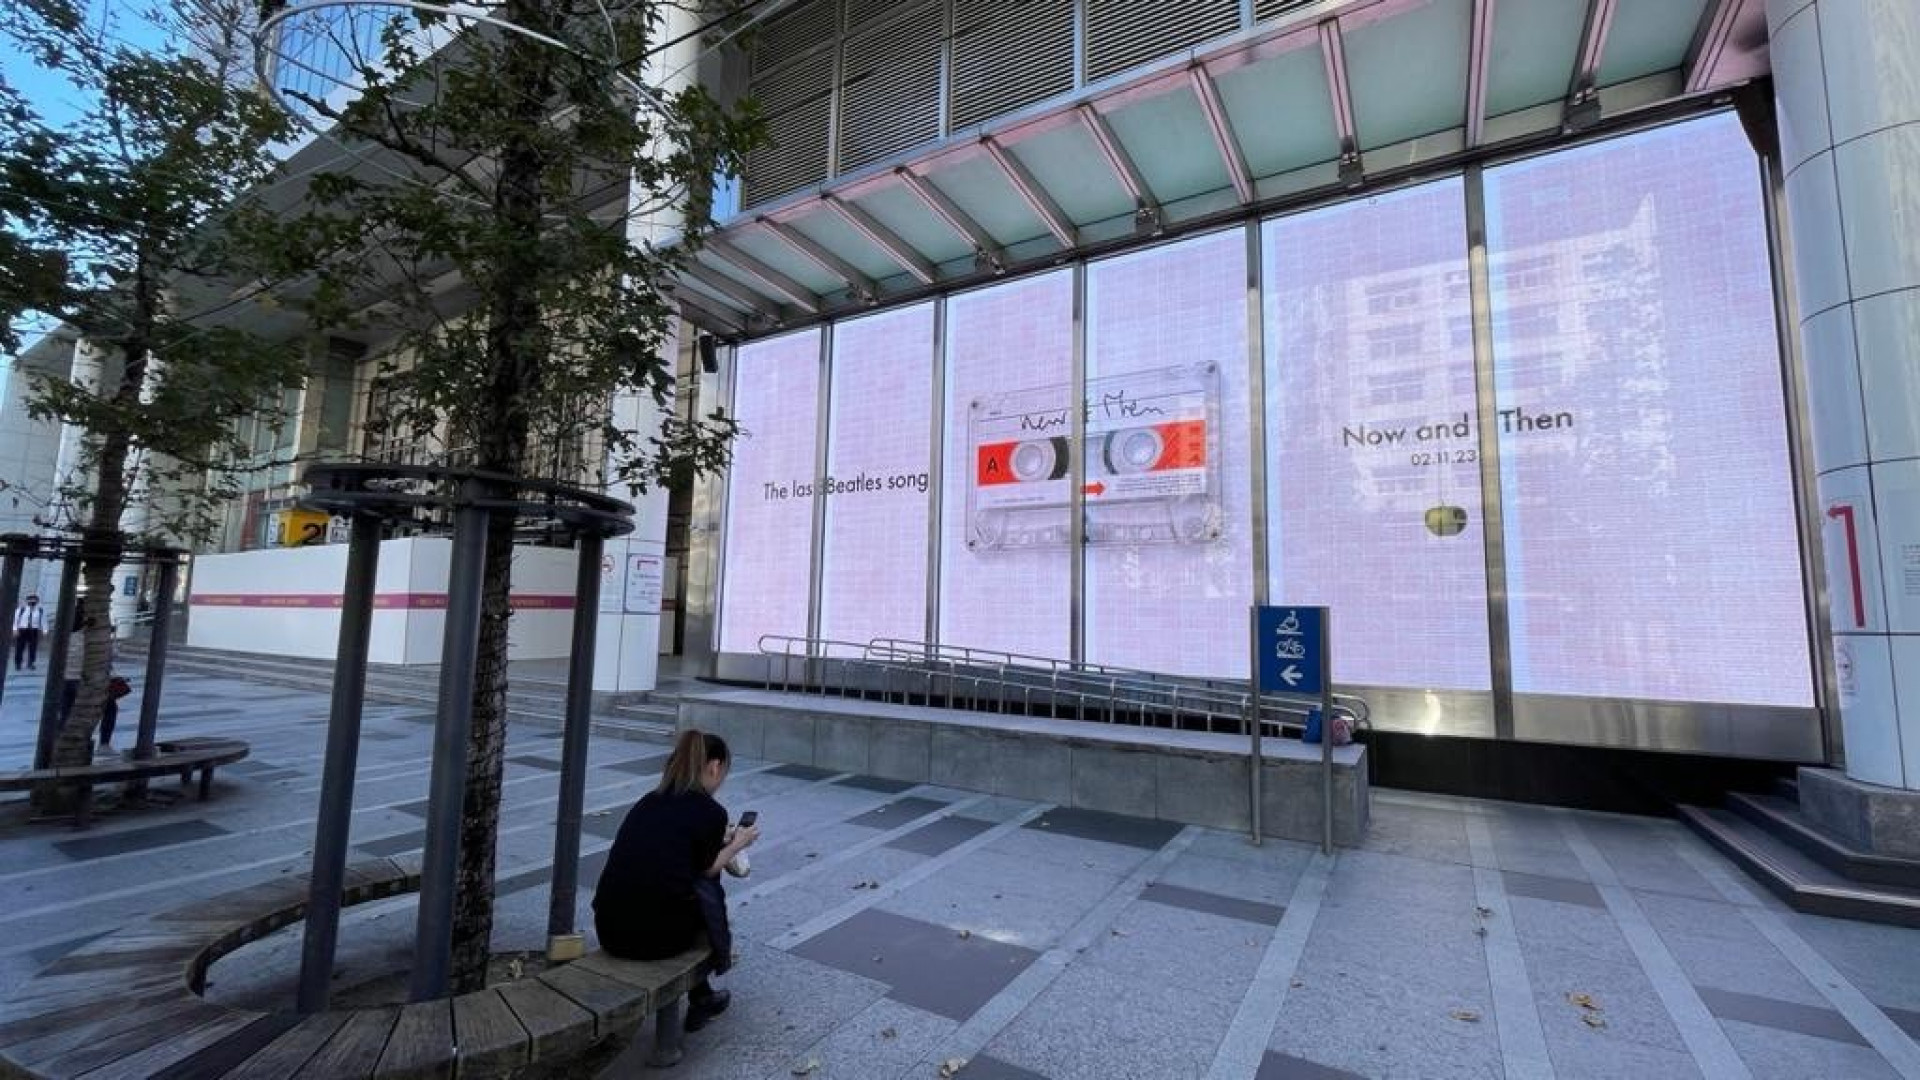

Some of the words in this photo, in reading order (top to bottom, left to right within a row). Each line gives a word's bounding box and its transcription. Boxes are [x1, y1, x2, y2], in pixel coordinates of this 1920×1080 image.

[1342, 425, 1406, 446] Now
[1415, 412, 1469, 441] and
[1499, 407, 1573, 433] Then
[986, 456, 999, 474] A
[1411, 449, 1477, 466] 02.11.23
[764, 482, 788, 500] The
[792, 480, 814, 497] las
[824, 472, 882, 494] Beatles
[888, 473, 929, 492] song
